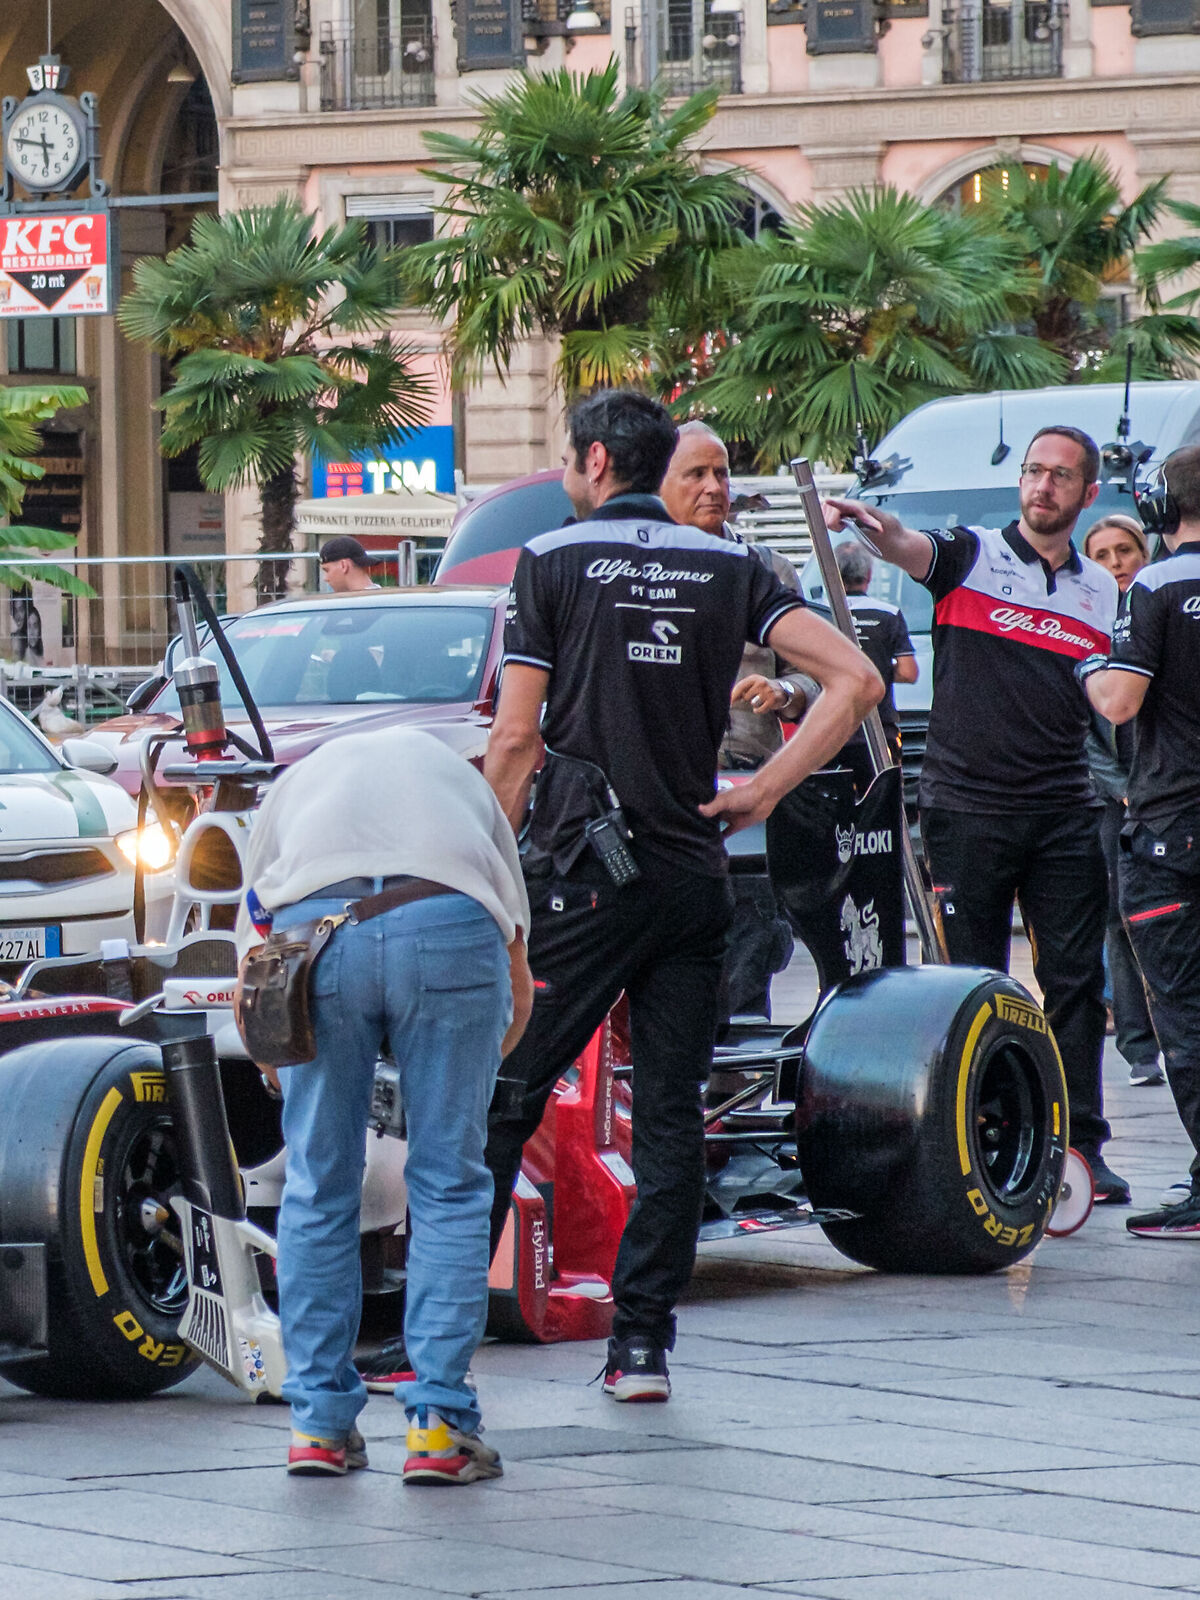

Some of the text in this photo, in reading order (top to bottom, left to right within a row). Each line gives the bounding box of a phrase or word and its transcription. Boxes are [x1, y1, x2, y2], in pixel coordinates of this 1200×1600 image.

[1, 217, 94, 256] KFC
[2, 253, 93, 268] RESTAURANT
[31, 274, 65, 289] 20 mt
[367, 459, 437, 495] TIM
[300, 514, 349, 526] ISTORANTE
[354, 515, 397, 527] PIZZERIA
[586, 559, 714, 584] Alfa Romeo
[631, 585, 676, 600] F1 EAM
[990, 608, 1038, 632] Alfa
[1036, 618, 1095, 650] Romeo
[854, 829, 892, 855] FLOKI
[8, 929, 40, 940] LOCALE
[207, 992, 236, 1003] ORL
[18, 1003, 91, 1018] EYEWEAR
[994, 993, 1047, 1034] PIRELLI
[967, 1188, 1036, 1248] ZERO
[533, 1220, 545, 1289] Hyland
[113, 1311, 188, 1367] ERO
